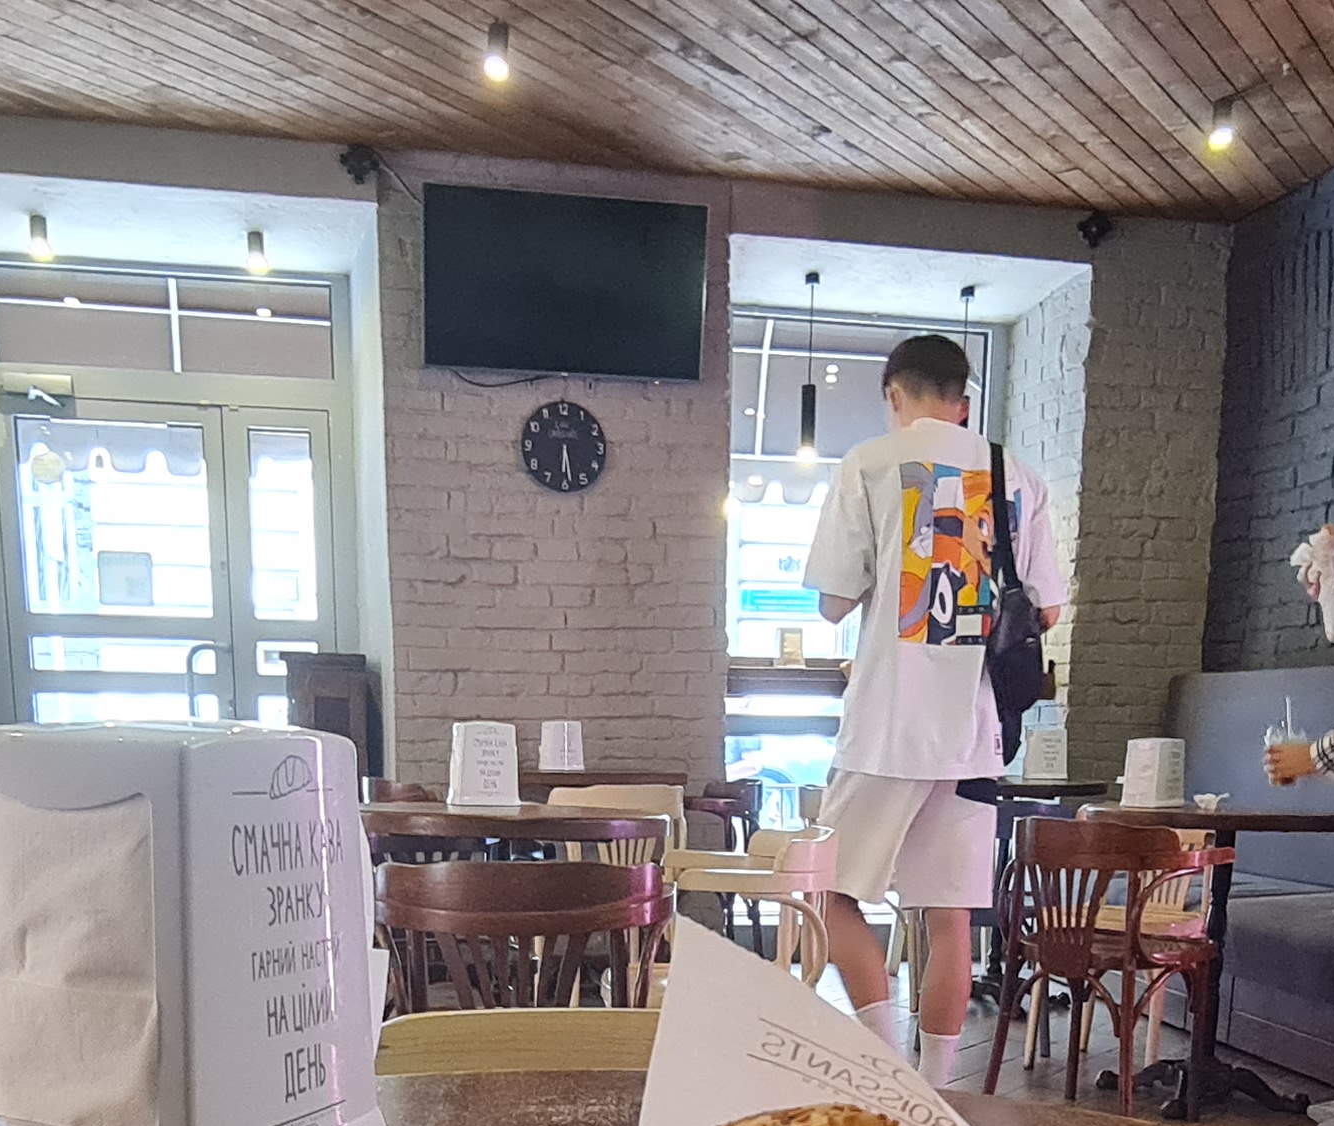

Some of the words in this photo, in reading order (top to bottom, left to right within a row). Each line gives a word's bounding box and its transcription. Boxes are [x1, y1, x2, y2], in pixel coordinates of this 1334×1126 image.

[541, 408, 550, 419] 11
[558, 403, 569, 416] 12
[579, 409, 585, 421] 1
[529, 421, 540, 433] 10
[591, 423, 600, 437] 2
[524, 439, 533, 452] 9
[596, 442, 605, 455] 3
[530, 458, 538, 471] 8
[591, 460, 599, 473] 4
[543, 471, 552, 483] 7
[578, 473, 589, 485] 5
[561, 479, 570, 491] 6
[231, 820, 305, 877] СМАЧНА
[266, 880, 325, 927] ЗРАНКУ
[251, 940, 297, 982] ГАРНИЙ
[266, 994, 290, 1038] НА
[292, 978, 334, 1034] ЦІЛИЙ
[284, 1042, 327, 1103] ДЕНЬ
